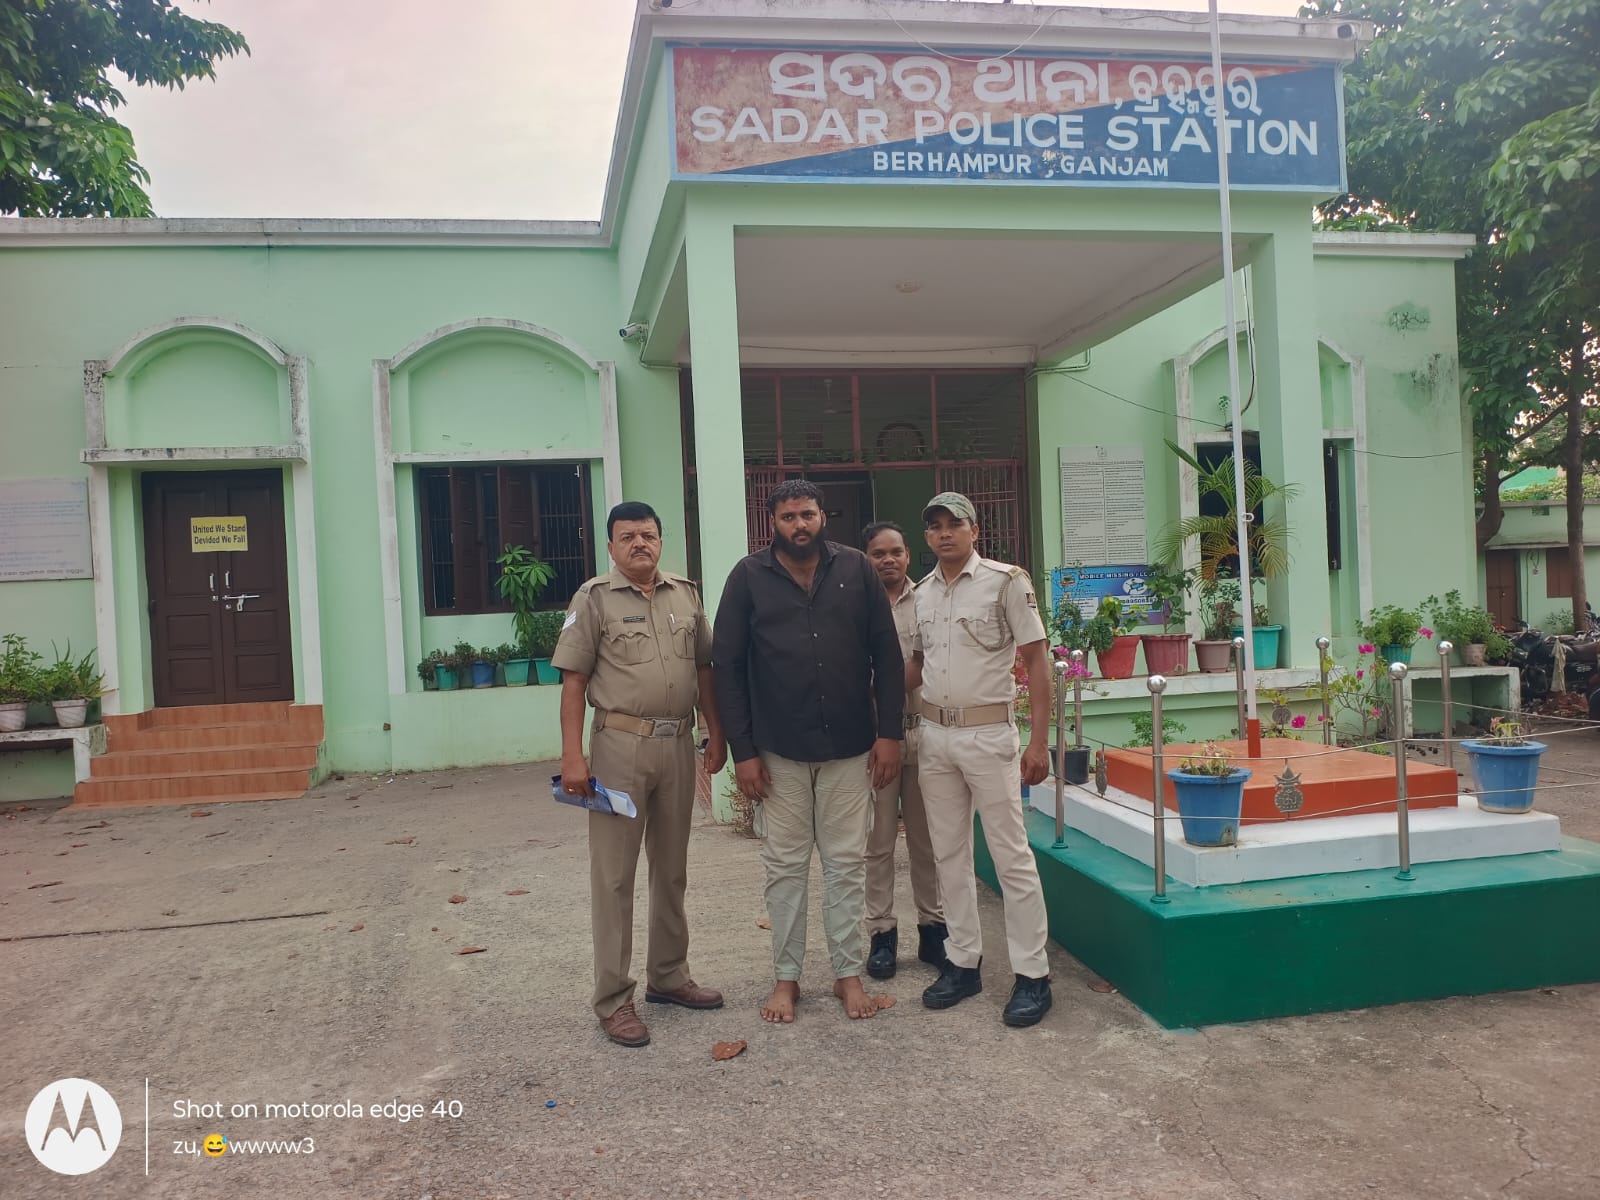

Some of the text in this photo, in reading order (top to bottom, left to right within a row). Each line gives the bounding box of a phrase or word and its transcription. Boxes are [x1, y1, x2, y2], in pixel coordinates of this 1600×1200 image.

[769, 52, 952, 113] ସଦର
[691, 106, 1318, 156] SADAR POLICE STATION
[873, 151, 1032, 174] BERHAMPUR
[193, 524, 246, 534] United We Stand
[222, 535, 232, 543] We
[233, 535, 246, 543] Fall
[1106, 571, 1134, 579] MISSING
